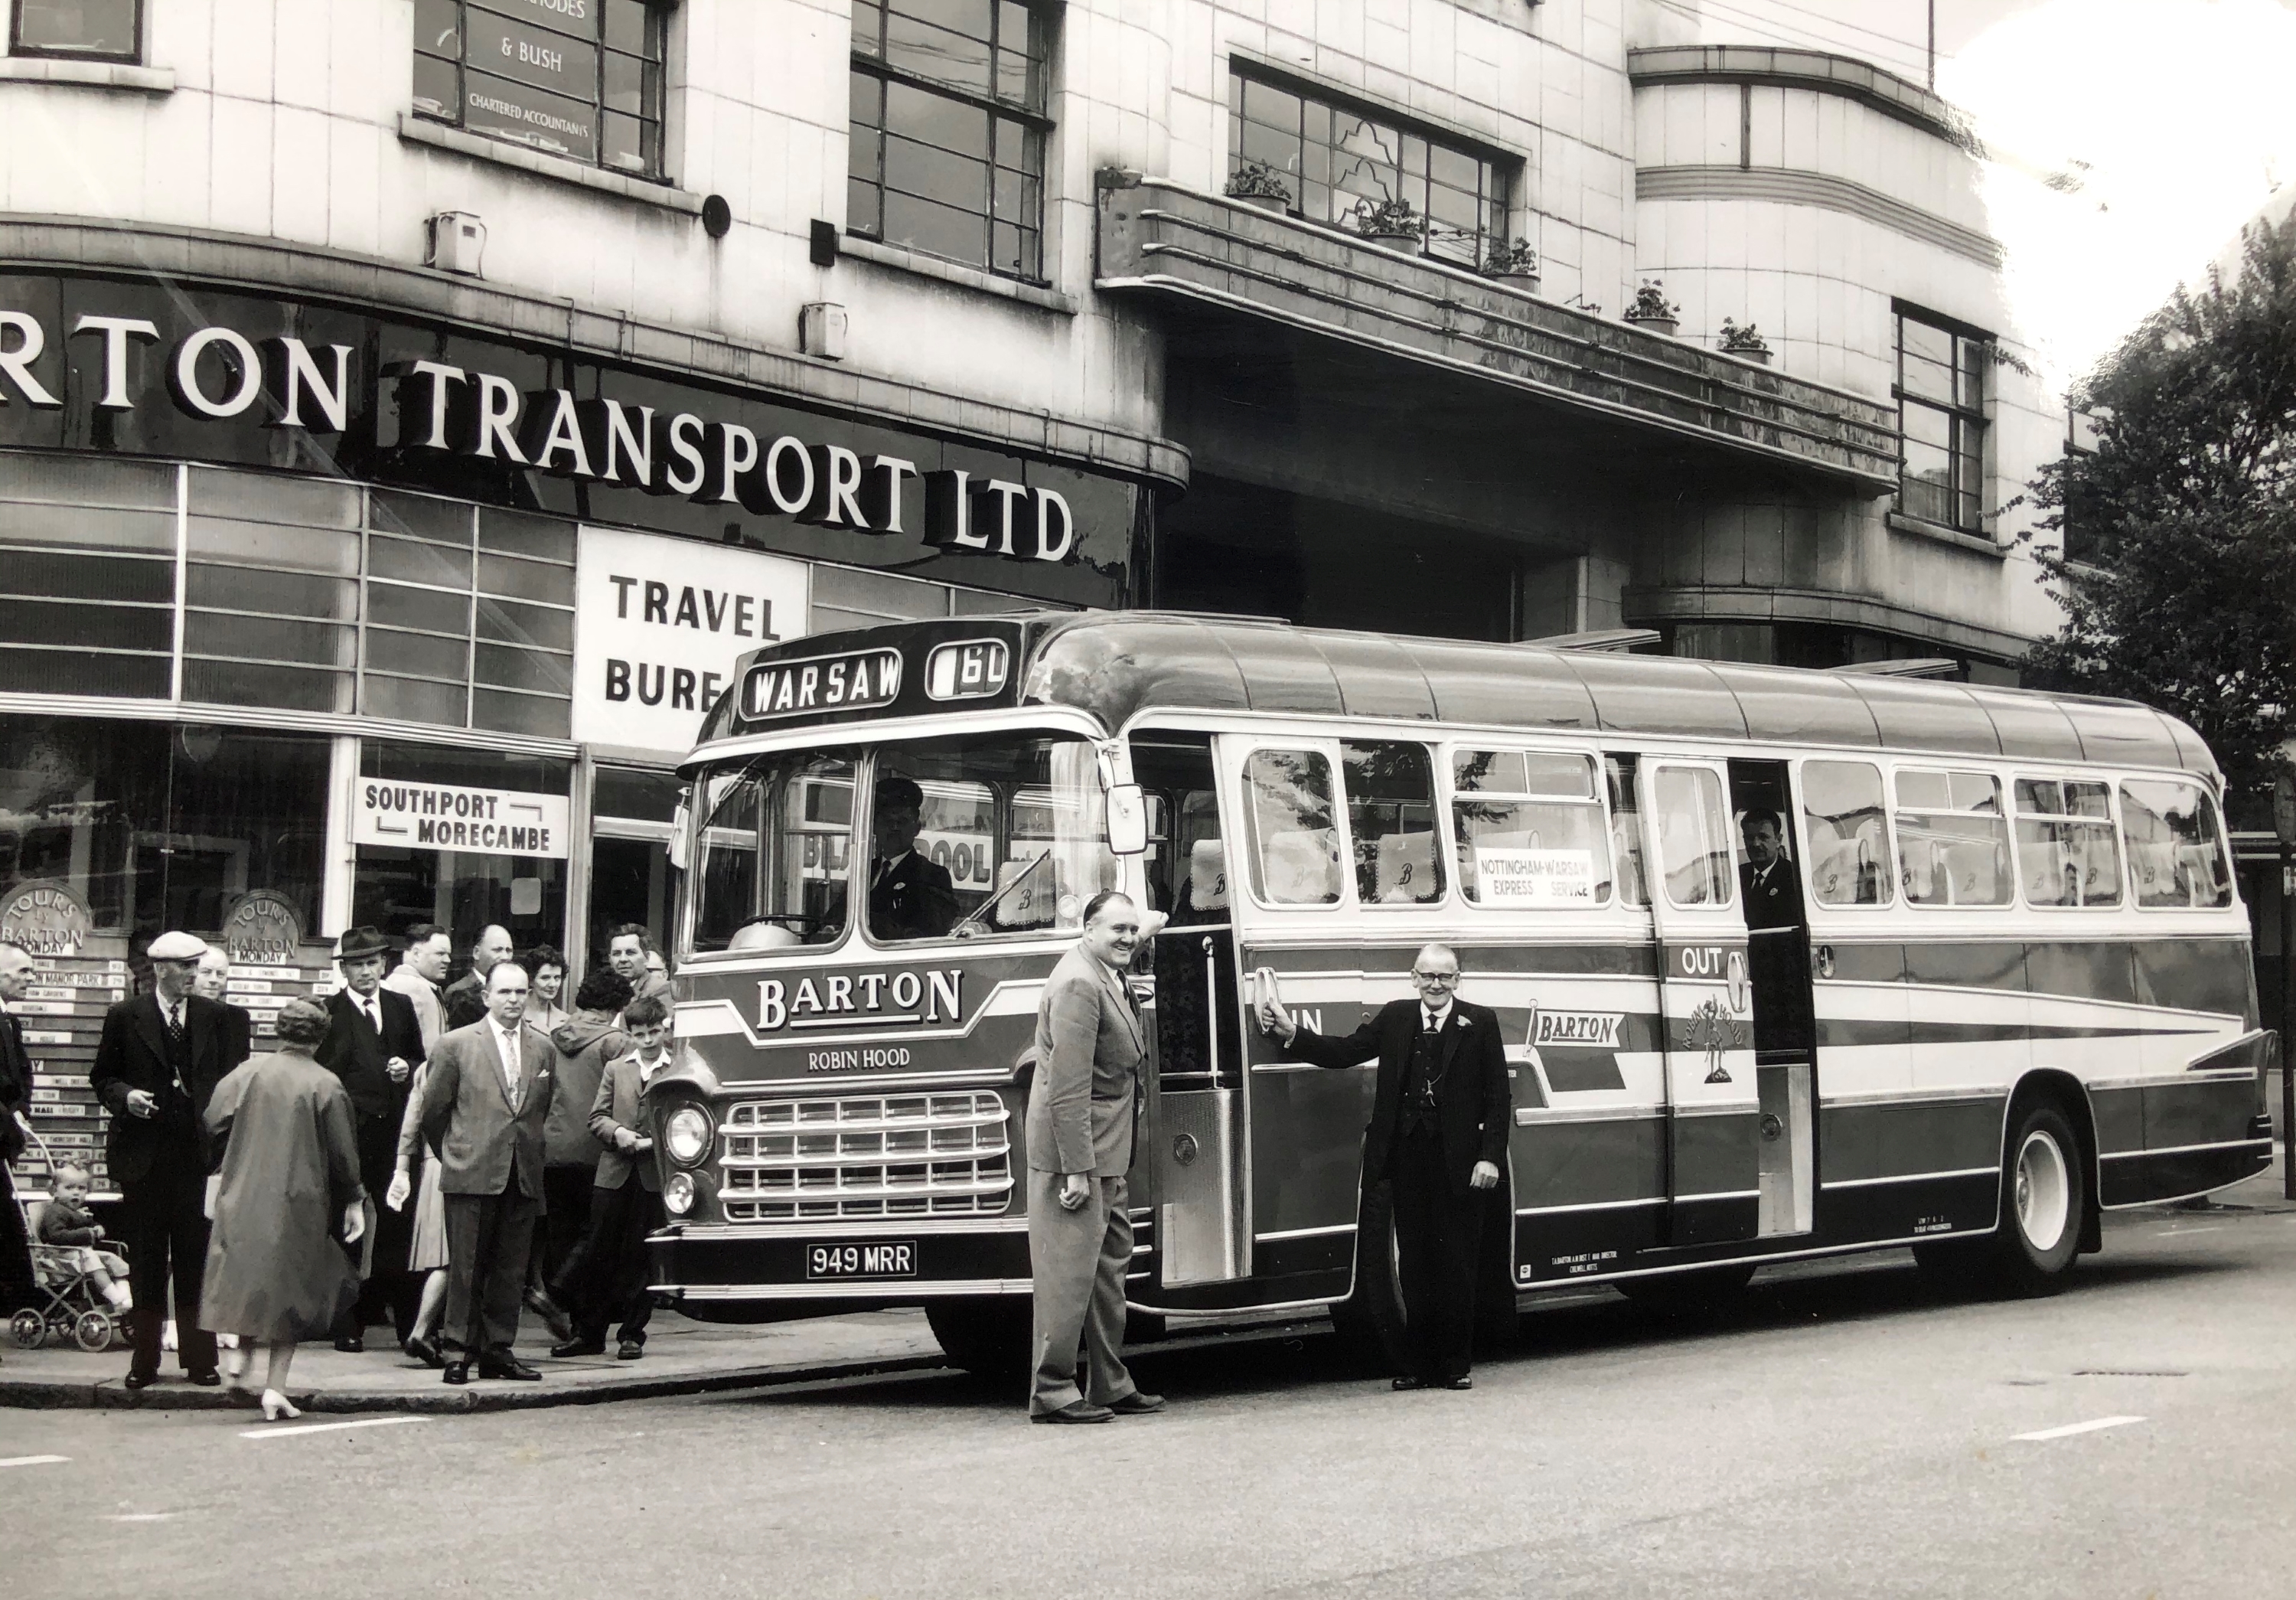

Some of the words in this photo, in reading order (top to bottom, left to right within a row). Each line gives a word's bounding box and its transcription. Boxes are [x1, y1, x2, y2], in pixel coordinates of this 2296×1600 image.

[524, 0, 585, 18] ODES
[501, 37, 513, 57] &
[519, 41, 562, 72] BUSH
[469, 93, 521, 119] CHARTERED
[523, 109, 588, 138] ACCOUNTANTS
[412, 360, 917, 534] TRANSPORT
[954, 470, 1073, 561] LTD
[609, 574, 781, 642] TRAVEL
[605, 658, 722, 713] BURE
[755, 655, 899, 714] WARSAW
[365, 784, 498, 820] SOUTHPORT
[417, 818, 550, 852] MORECAMBE
[1493, 880, 1534, 896] EXPRESS
[1551, 881, 1588, 897] SERVICE
[7, 890, 77, 919] TOURS
[233, 900, 291, 927] TOURS
[2, 926, 83, 950] BARTON
[229, 936, 295, 959] BARTON
[240, 950, 282, 964] MONDAY
[1681, 947, 1722, 975] OUT
[77, 974, 99, 985] PARK
[757, 969, 963, 1030] BARTON
[1292, 1008, 1322, 1035] IN
[1539, 1015, 1613, 1043] BARTON
[809, 1050, 858, 1071] ROBIN
[863, 1047, 910, 1068] HOOD
[813, 1246, 859, 1274] 949
[864, 1245, 911, 1272] MRR
